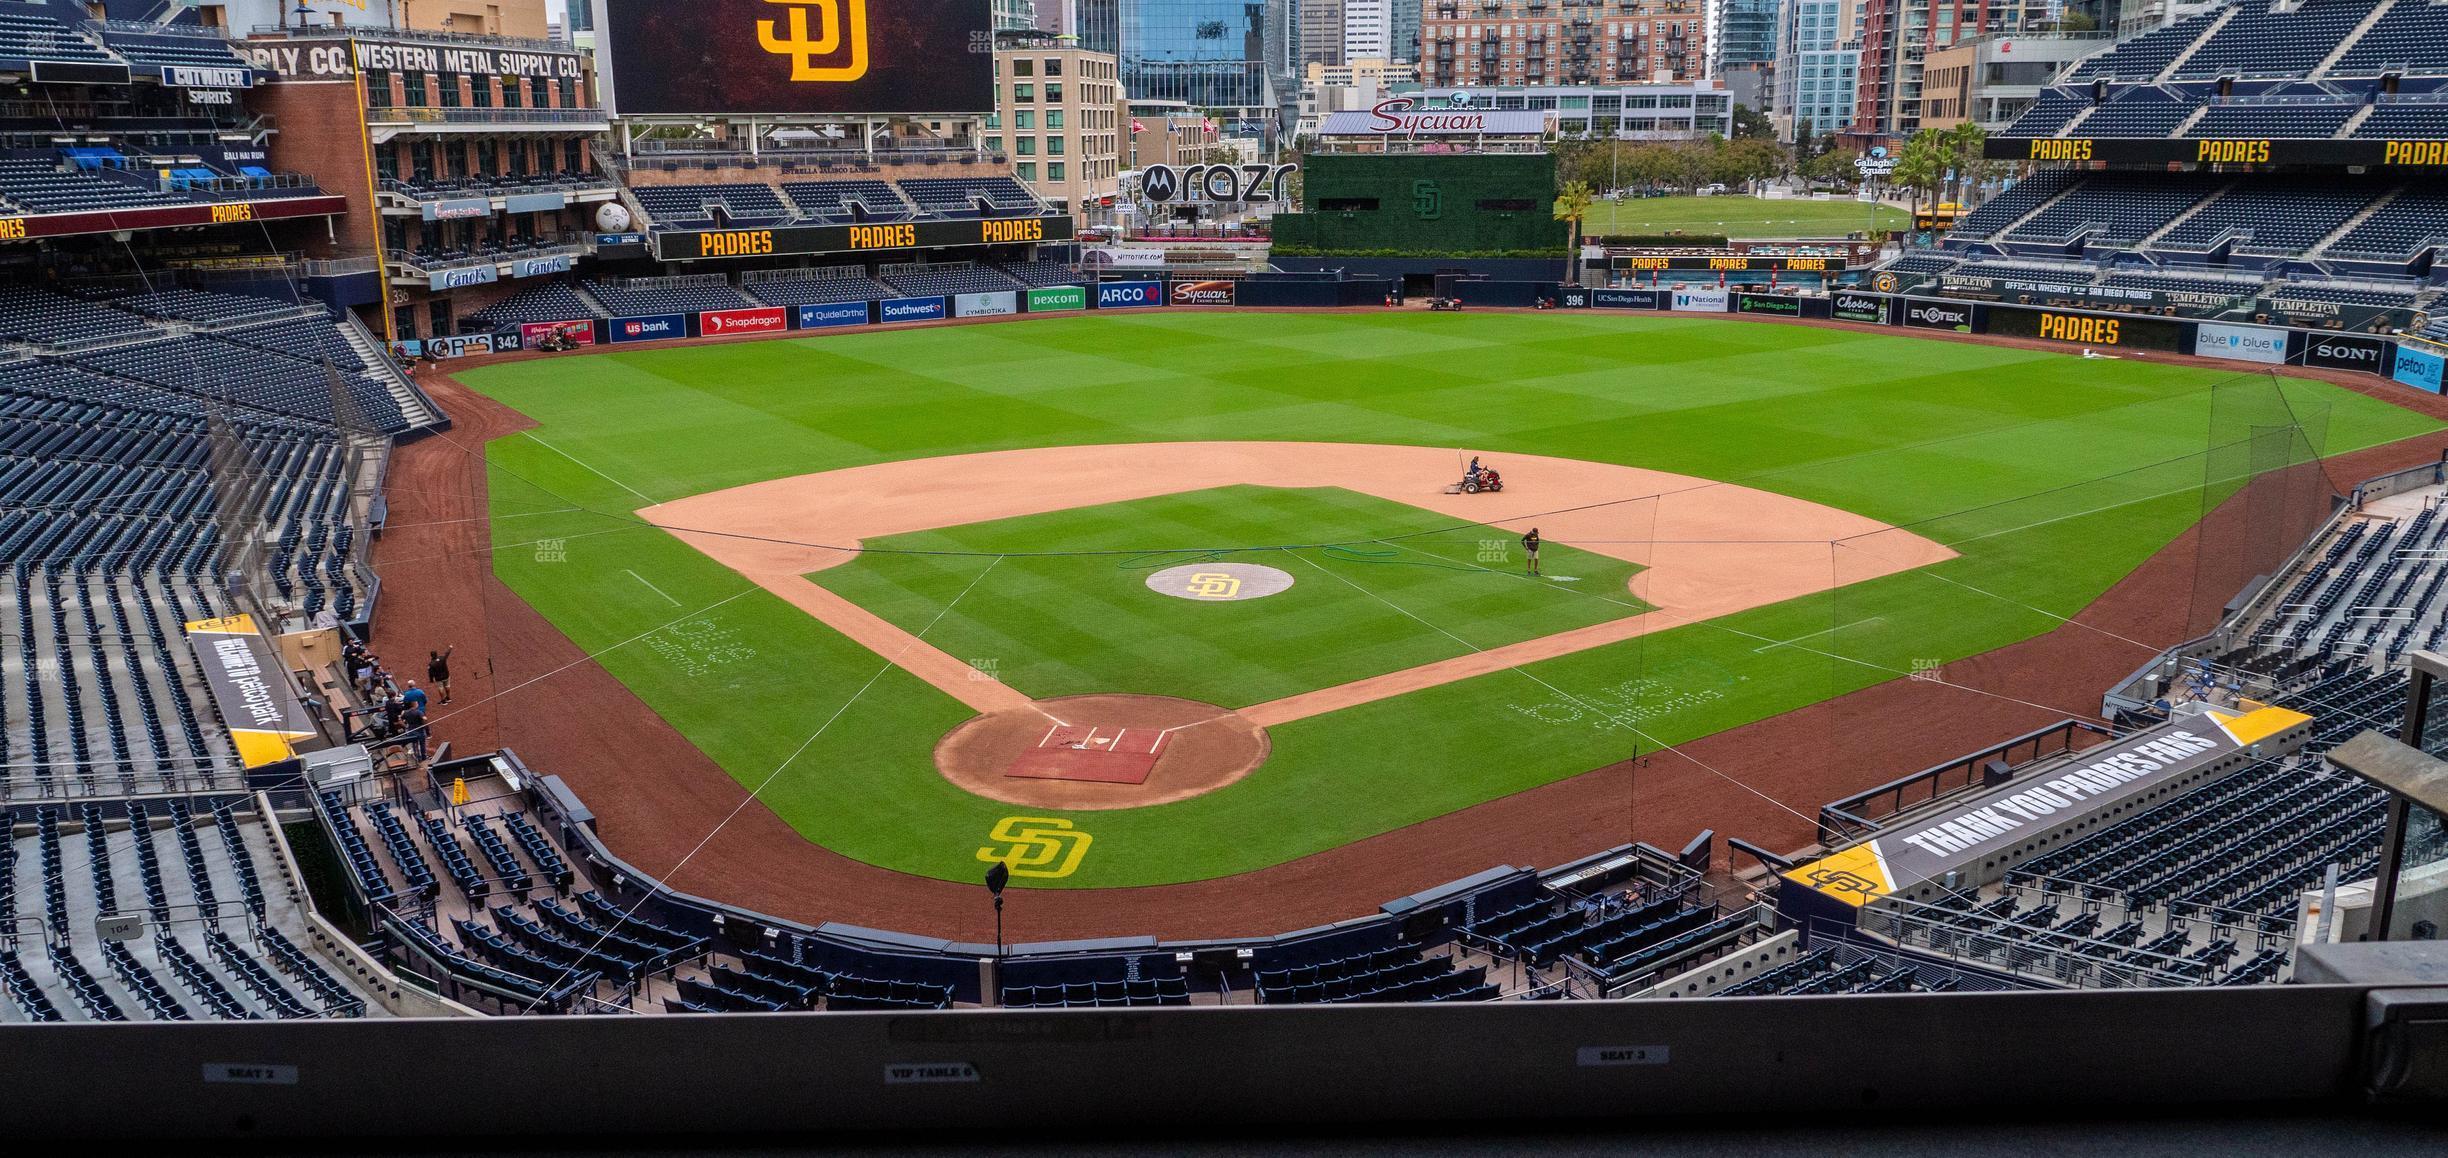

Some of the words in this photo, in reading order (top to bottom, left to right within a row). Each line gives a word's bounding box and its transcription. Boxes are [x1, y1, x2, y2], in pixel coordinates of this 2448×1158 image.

[310, 46, 354, 75] CO.
[354, 42, 438, 71] WESTERN
[445, 49, 497, 74] METAL
[499, 53, 552, 76] SUPPLY
[558, 56, 581, 78] CO.
[174, 68, 245, 87] CUTWATER
[188, 90, 233, 104] SPIRITS
[1369, 97, 1487, 141] Sycuan
[223, 151, 238, 161] BALI
[251, 152, 265, 160] RUM
[2030, 139, 2092, 160] PADRES
[2197, 139, 2270, 163] PADRES
[1859, 167, 1892, 176] Square
[1182, 163, 1298, 201] razr
[211, 204, 252, 223] PADRES
[850, 225, 916, 249] PADRES
[982, 219, 1042, 242] PADRES
[701, 230, 773, 257] PADRES
[525, 255, 562, 276] Canel's
[1632, 258, 1669, 269] PADRES
[1710, 257, 1748, 270] PADRES
[1787, 257, 1826, 270] PADRES
[444, 267, 487, 288] Canel's
[1942, 276, 1993, 289] TEMPLETON
[393, 289, 410, 304] 336
[1101, 287, 1144, 302] ARCO
[1174, 282, 1229, 304] Sycuan
[2004, 281, 2037, 291] OFFICIAL
[2038, 283, 2072, 294] WHISKEY
[2088, 287, 2103, 295] SAN
[2104, 288, 2123, 298] DIEGO
[2125, 290, 2153, 299] PADRES
[1566, 294, 1584, 306] 396
[1618, 295, 1633, 304] Diego
[1633, 295, 1653, 304] Health
[1692, 295, 1725, 304] National
[1753, 300, 1766, 309] San
[1766, 301, 1784, 311] Diego
[1836, 295, 1877, 310] Chosen
[2165, 292, 2230, 307] TEMPLETON
[2271, 299, 2341, 315] TEMPLETON
[815, 308, 865, 322] QuidelOrtho
[885, 303, 934, 317] Southwest
[965, 307, 1007, 316] CYMBIOTIKA
[1910, 306, 1965, 323] EVOTEK
[642, 320, 670, 332] bank
[725, 314, 781, 329] Snapdragon
[2039, 312, 2120, 345] PADRES
[497, 334, 518, 350] 342
[2199, 332, 2227, 345] blue
[2242, 336, 2270, 349] blue
[2316, 344, 2379, 361] SONY
[2396, 357, 2426, 376] petco
[228, 676, 271, 703] petco
[240, 700, 284, 726] park
[1903, 806, 2024, 858] THANK
[1992, 780, 2073, 821] YOU
[2053, 752, 2164, 802] PADRES
[2137, 730, 2218, 765] FANS
[110, 924, 130, 935] 104
[1600, 1050, 1634, 1061] SEAT
[1637, 1050, 1646, 1060] 3
[228, 1068, 262, 1079] SEAT
[892, 1069, 914, 1079] VIP
[917, 1068, 959, 1078] TABLE
